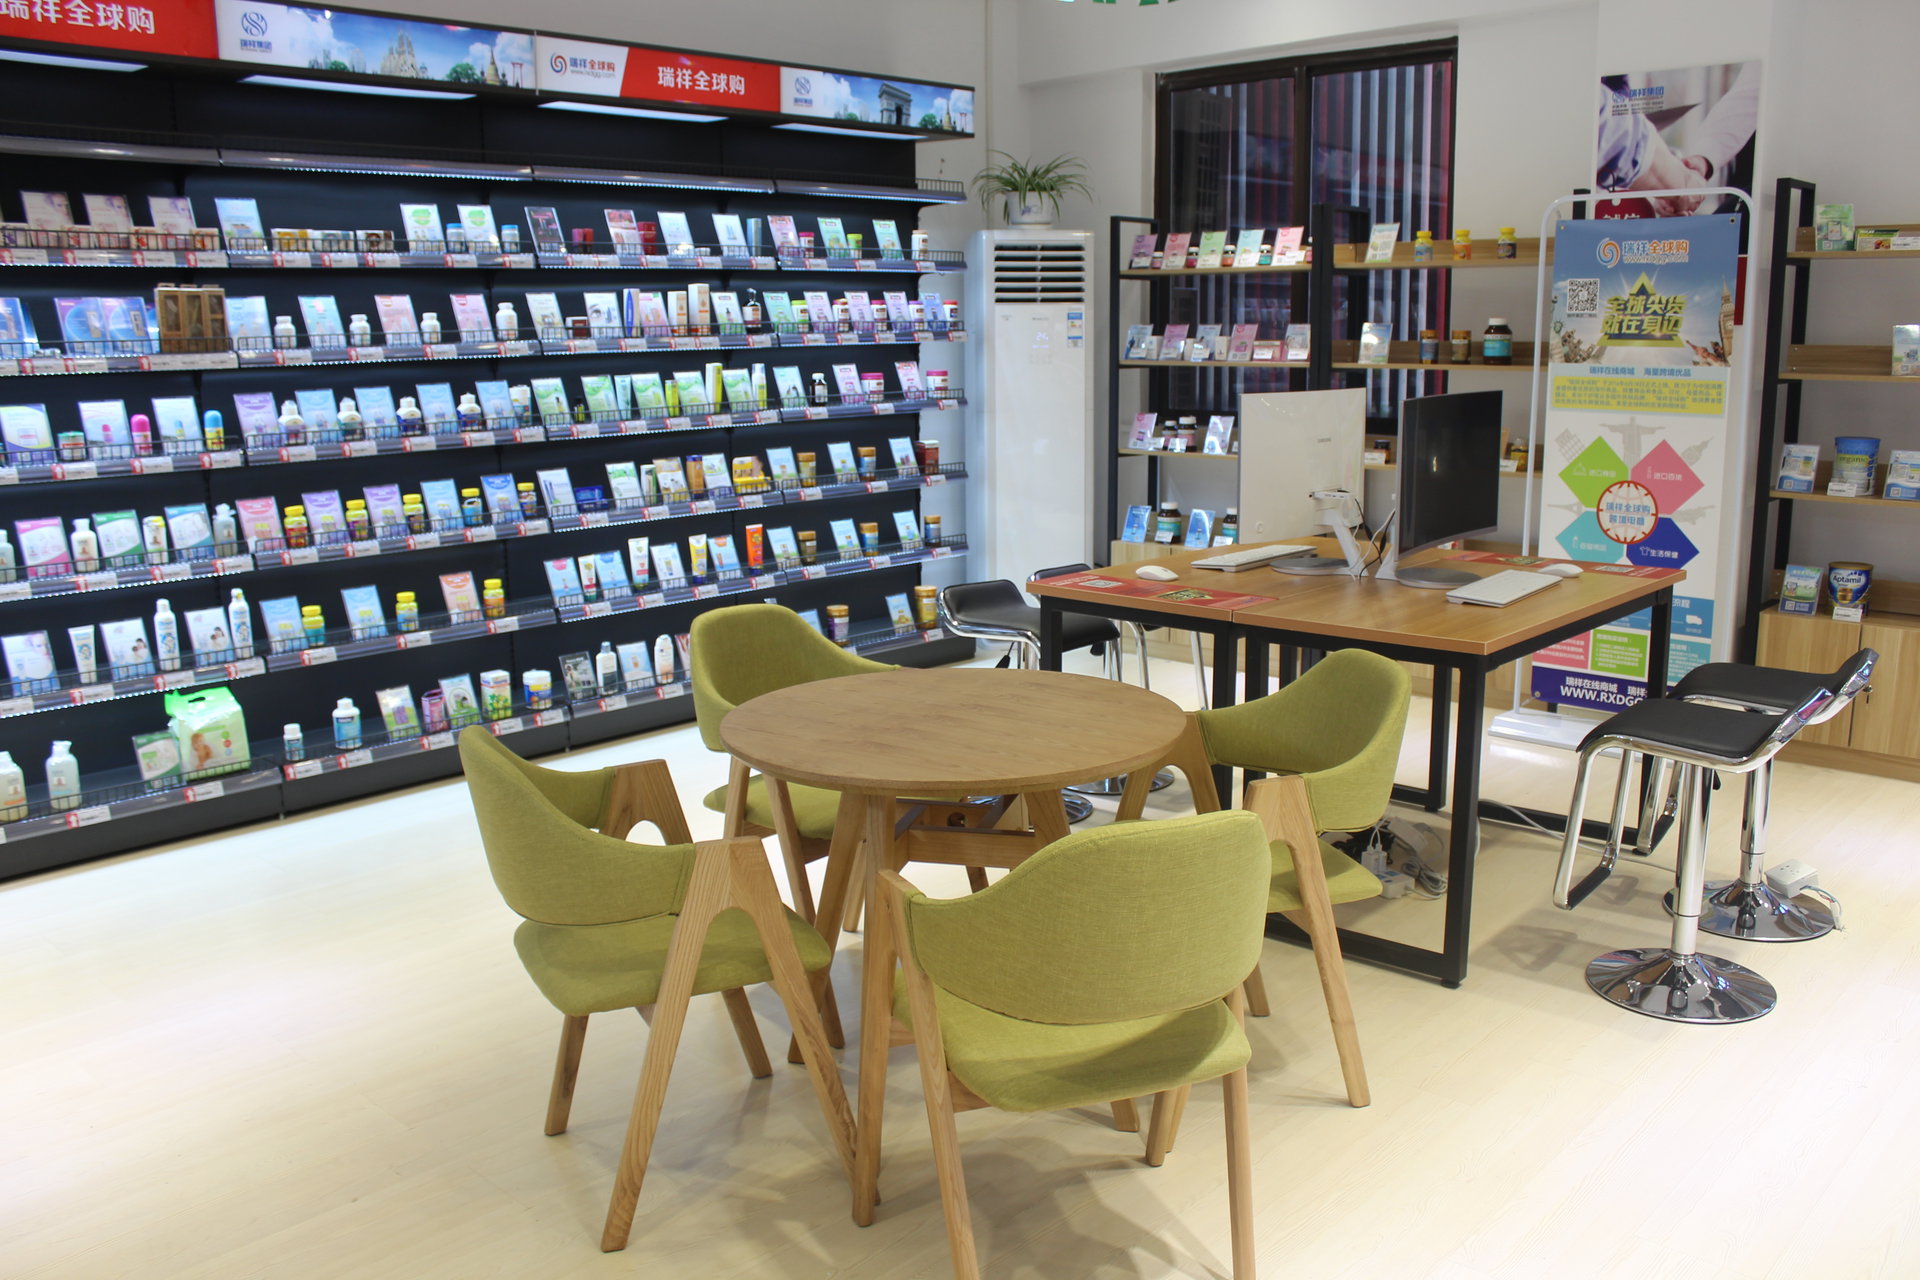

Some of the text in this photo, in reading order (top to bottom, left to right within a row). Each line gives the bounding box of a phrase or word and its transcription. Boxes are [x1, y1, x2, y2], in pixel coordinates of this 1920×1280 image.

[0, 0, 156, 34] 瑞祥全球购
[657, 66, 745, 95] 瑞祥全球购
[1622, 240, 1689, 256] 瑞祥全球购
[1604, 295, 1687, 315] 全球尖货
[1600, 314, 1684, 335] 就在身边
[1832, 574, 1862, 585] Aptamil
[1565, 676, 1618, 693] 瑞祥在线商城
